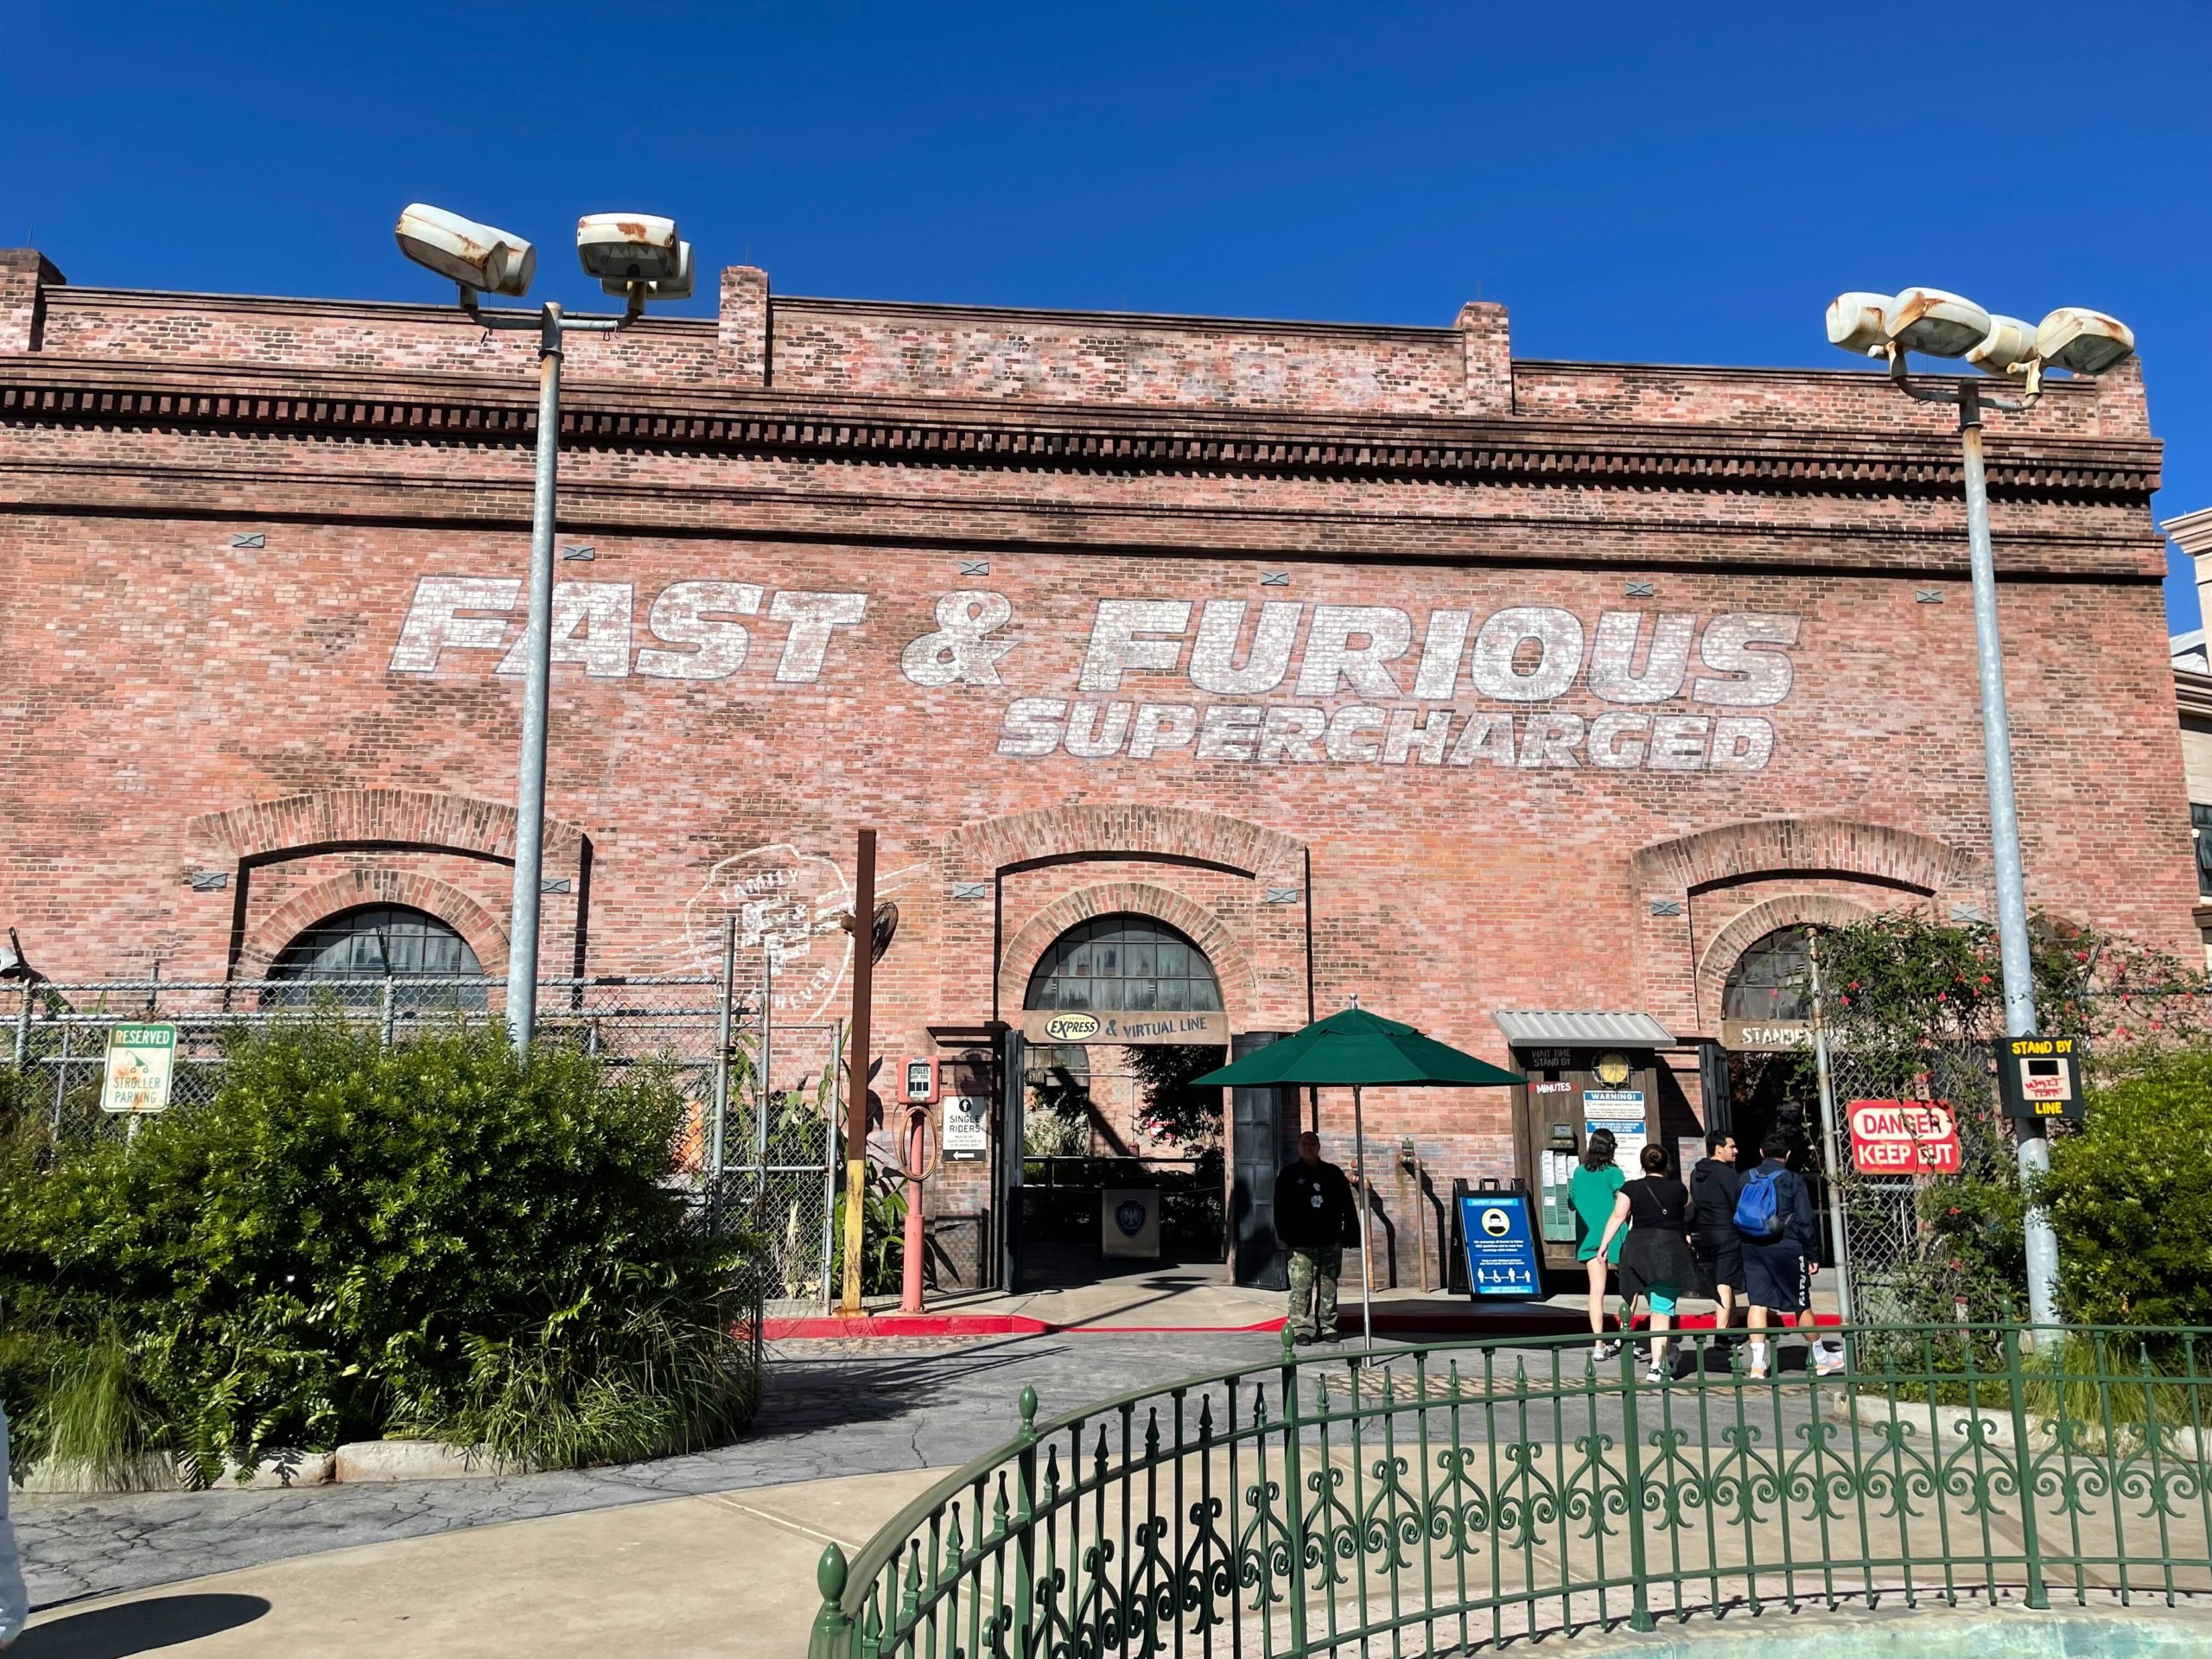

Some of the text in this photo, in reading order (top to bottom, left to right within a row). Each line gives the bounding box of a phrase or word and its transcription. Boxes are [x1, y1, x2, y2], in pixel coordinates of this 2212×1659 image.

[388, 575, 1802, 708] FAST & FURIOUS
[996, 696, 1776, 772] SUPERCHARGED
[1050, 1017, 1208, 1038] EXPRESS & VIRTUAL LINE
[115, 1030, 170, 1045] RESERVED
[1531, 1048, 1571, 1058] WAIT TIME
[2012, 1039, 2073, 1055] STAND BY
[1534, 1057, 1571, 1067] STAND BY
[113, 1077, 161, 1089] STROLLER
[1536, 1083, 1572, 1094] MINUTES
[114, 1091, 156, 1103] PARKING
[2035, 1102, 2063, 1115] LINE
[950, 1115, 981, 1123] SINGLE
[1863, 1114, 1942, 1135] DANGER
[950, 1124, 981, 1133] RIDERS
[1858, 1144, 1911, 1165] KEEP
